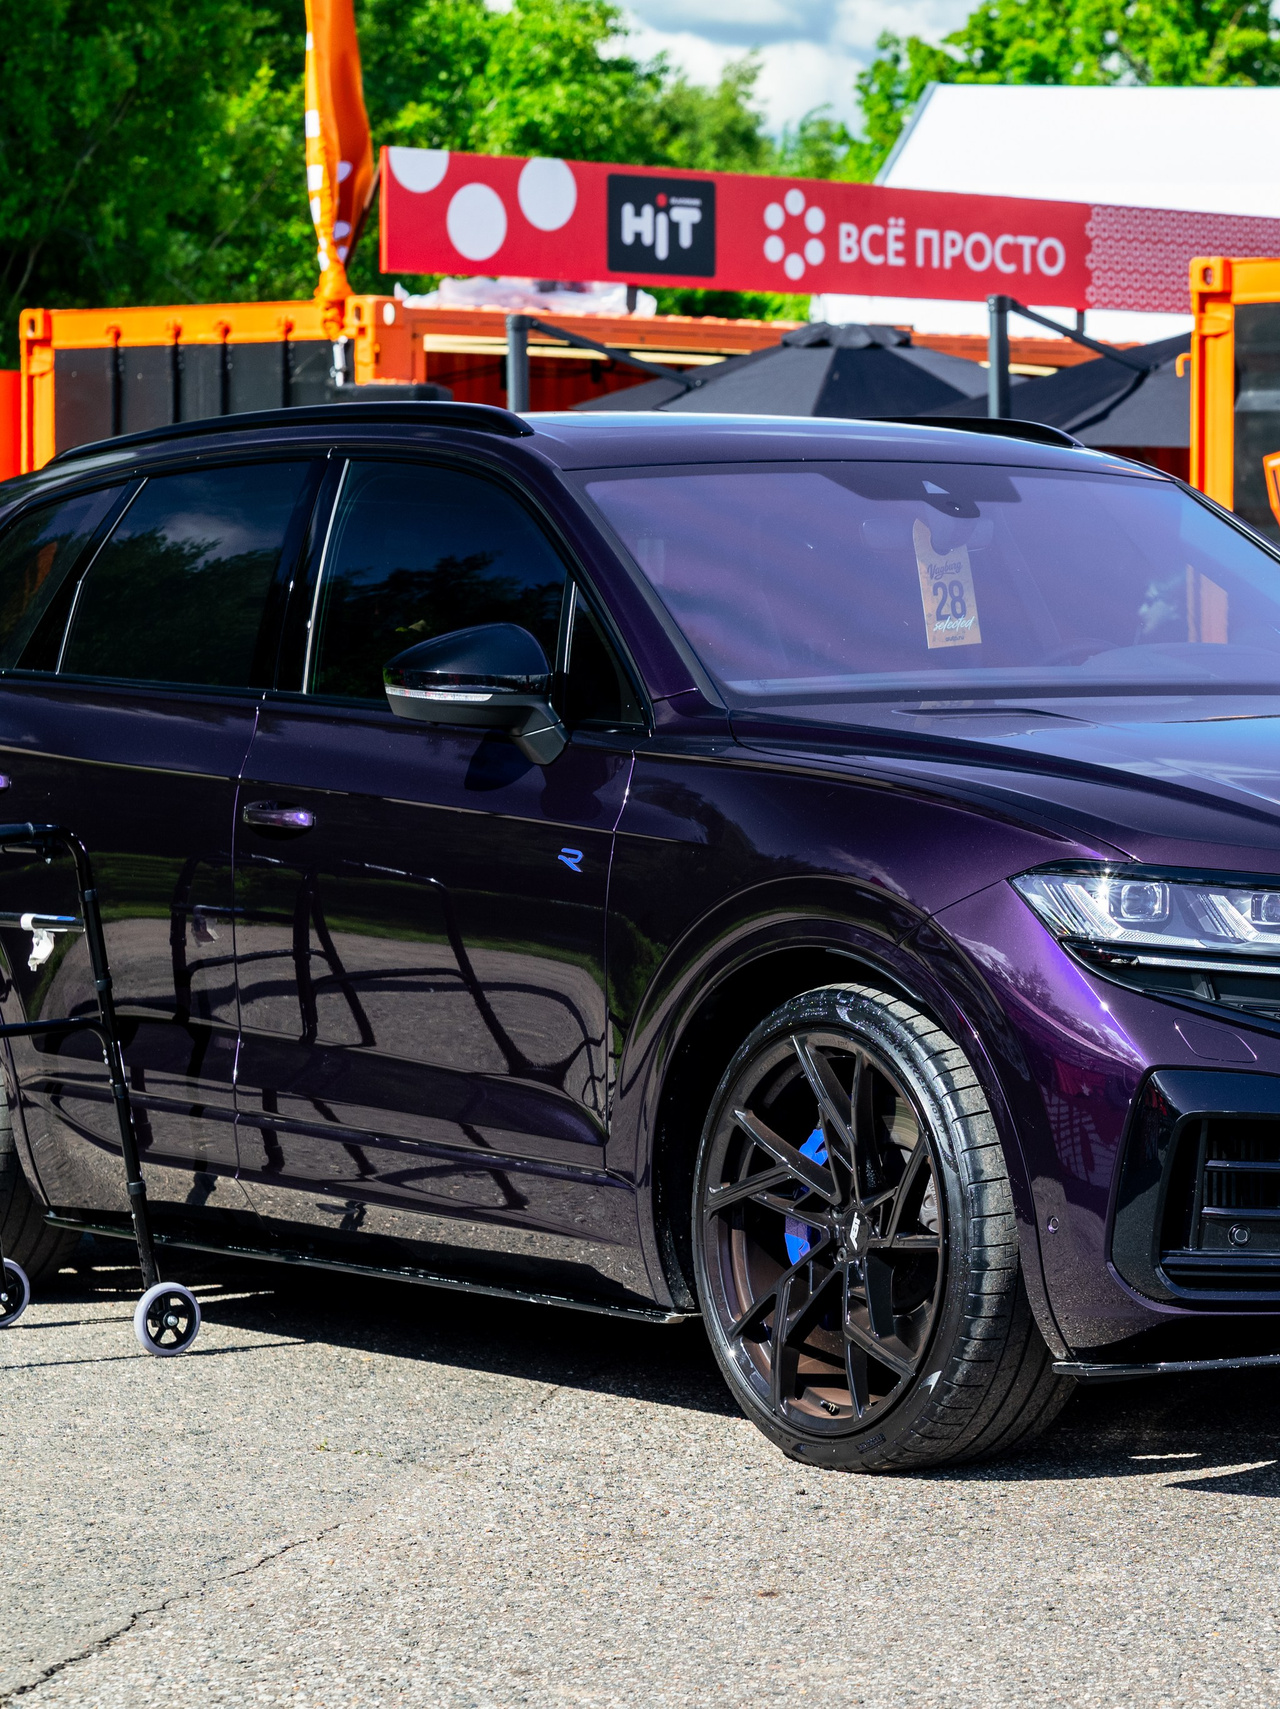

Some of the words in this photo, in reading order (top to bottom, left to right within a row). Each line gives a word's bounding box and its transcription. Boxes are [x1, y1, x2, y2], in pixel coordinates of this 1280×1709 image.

[621, 193, 702, 261] HiT
[839, 217, 906, 267] ВСЁ
[916, 228, 1066, 277] ПРОСТО
[933, 580, 967, 621] 28
[933, 615, 975, 632] selected
[558, 848, 583, 873] R
